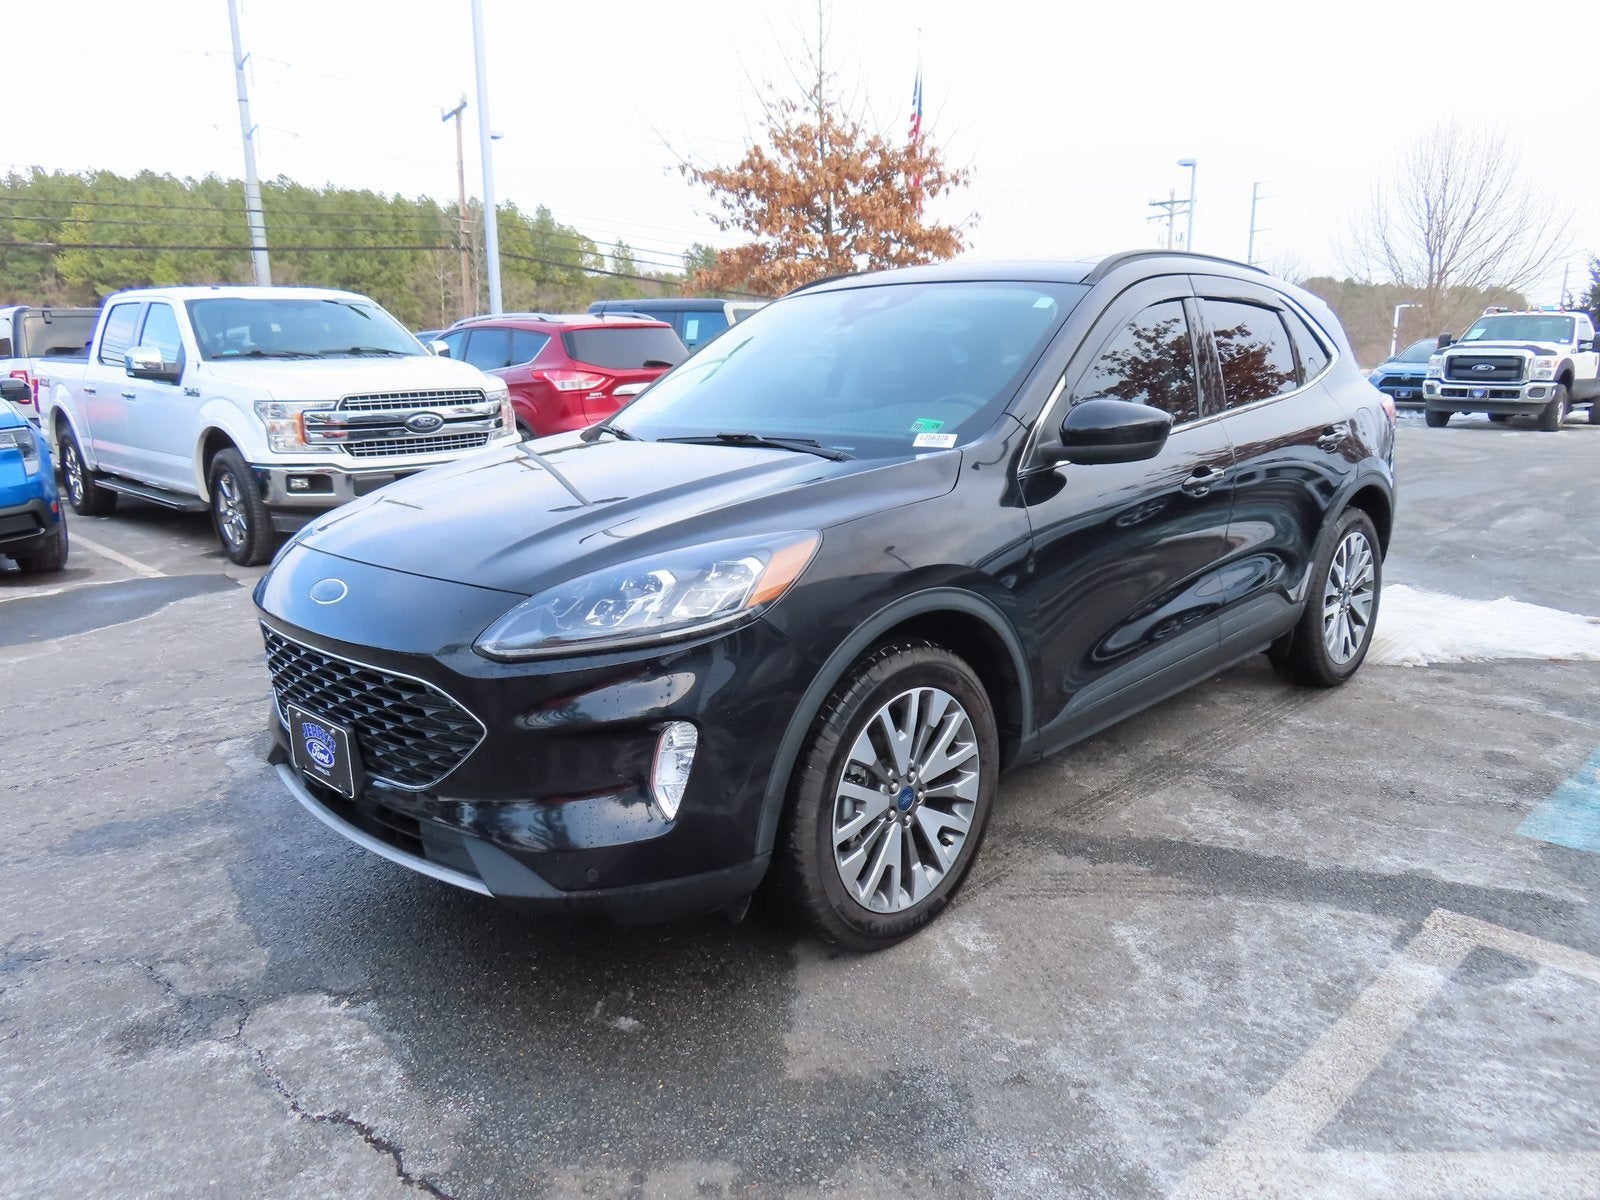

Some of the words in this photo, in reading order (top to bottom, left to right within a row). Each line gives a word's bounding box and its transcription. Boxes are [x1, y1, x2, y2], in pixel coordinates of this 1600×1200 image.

[416, 416, 436, 427] Ford
[302, 722, 336, 754] JERRY'S
[311, 742, 330, 764] Ford
